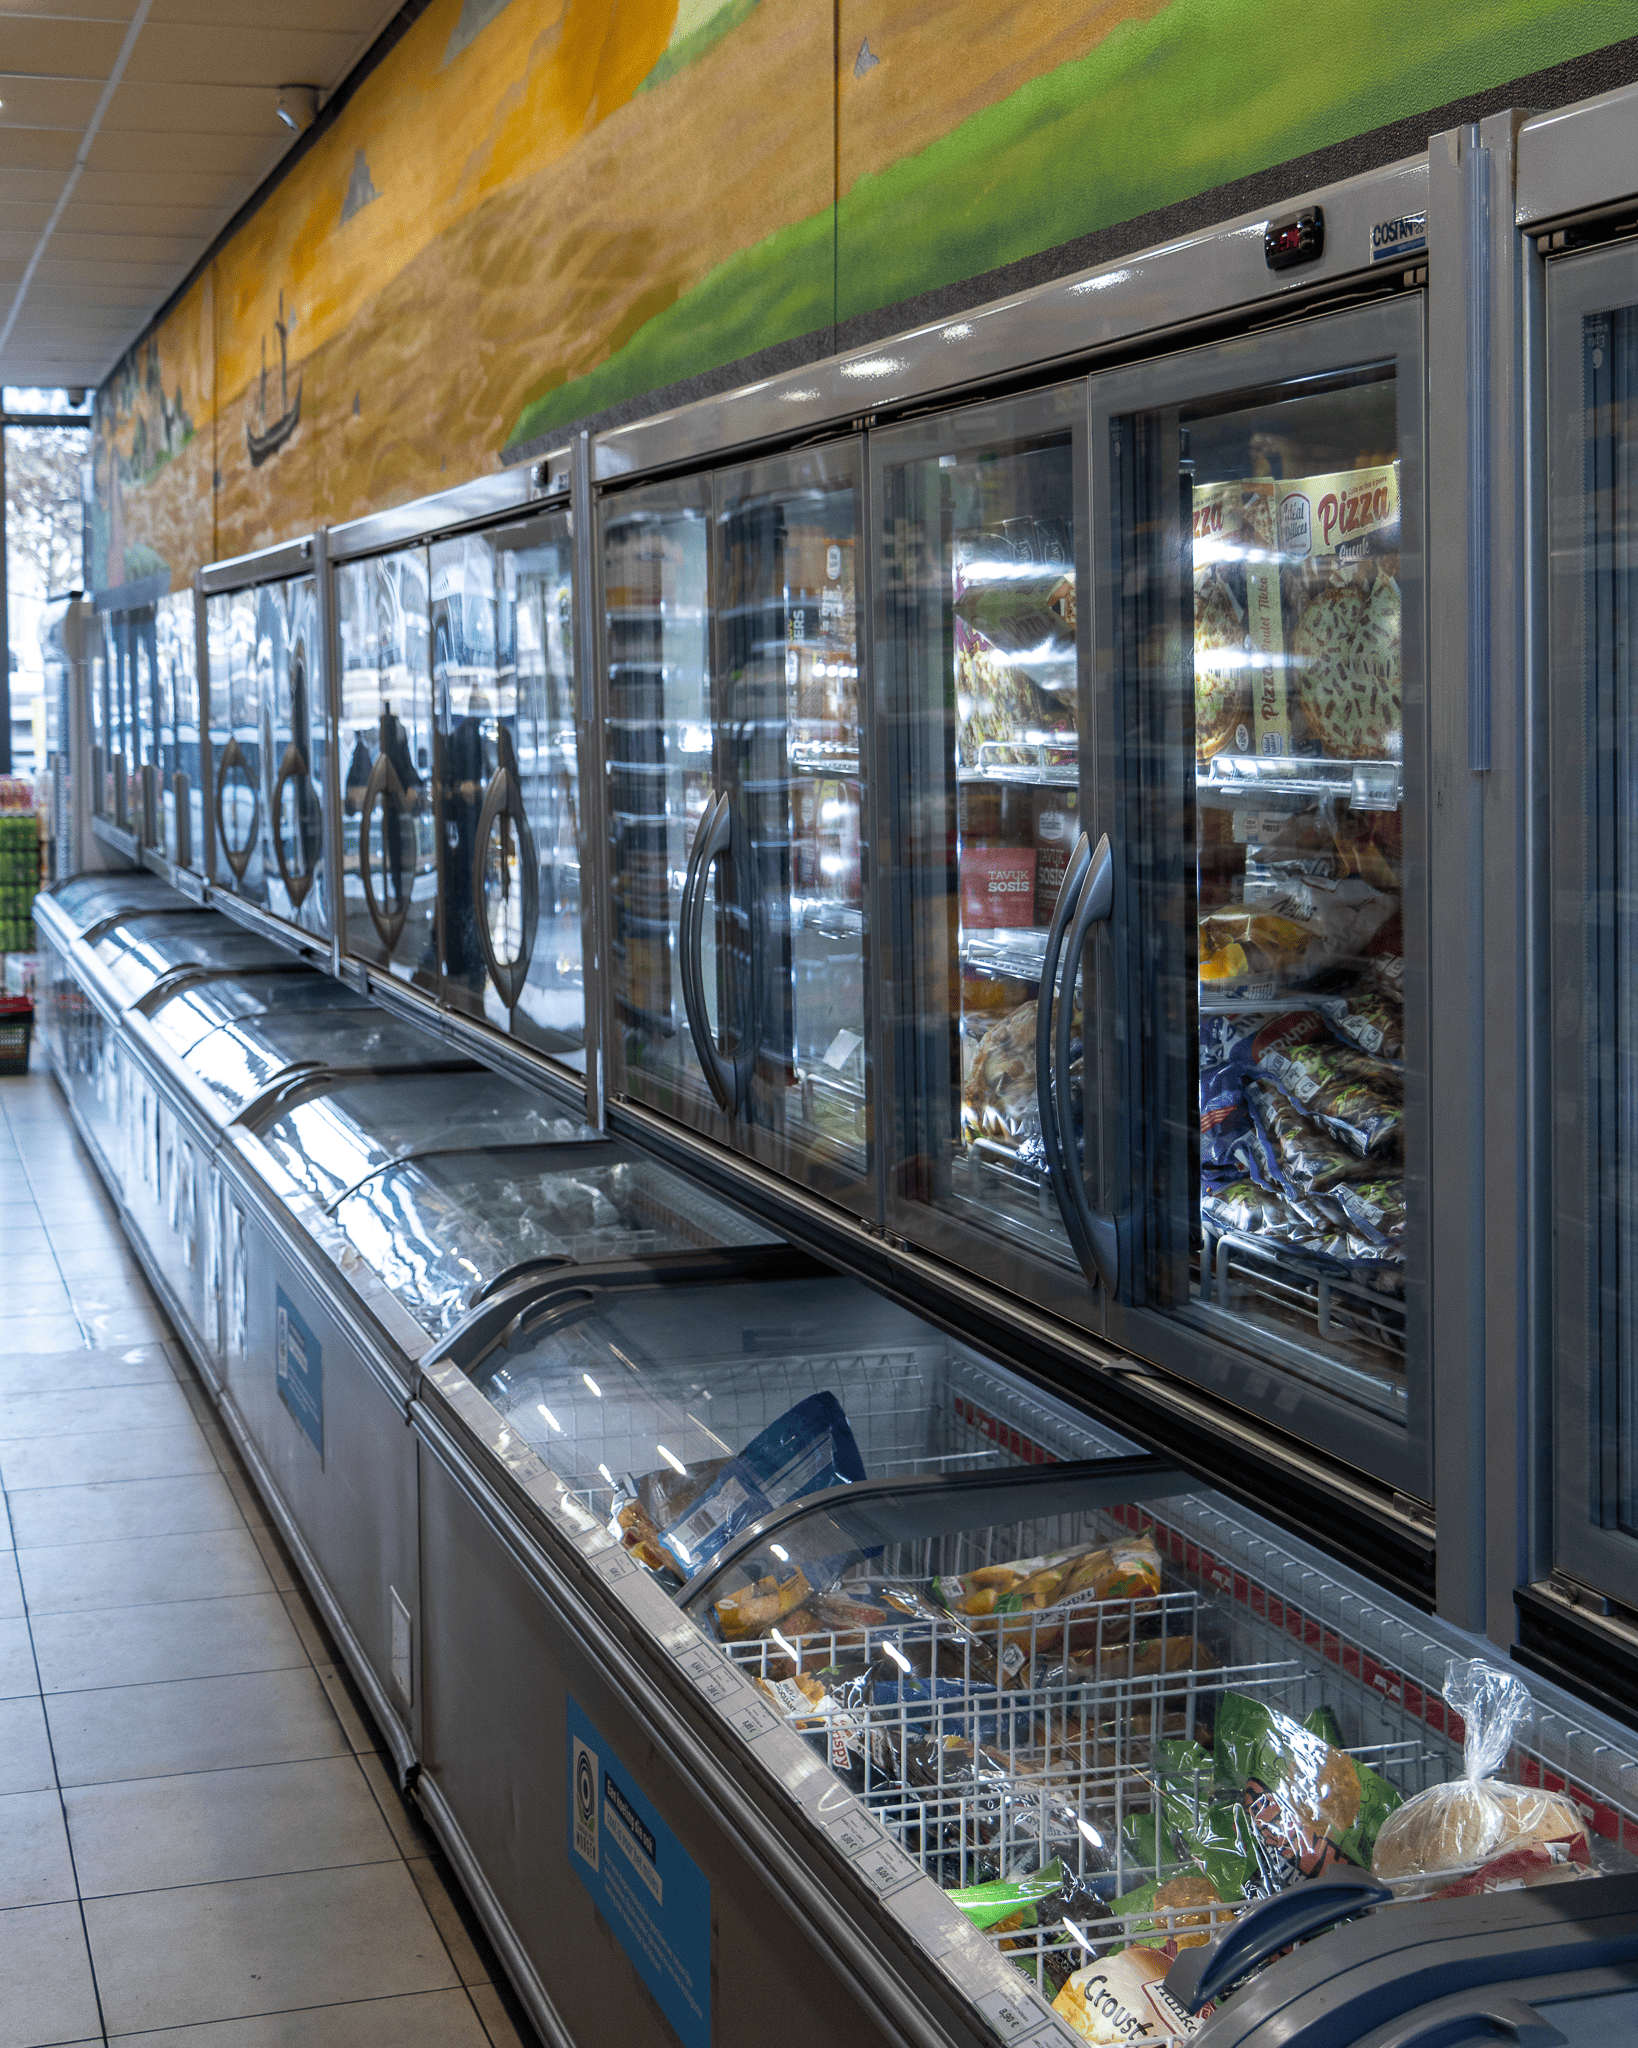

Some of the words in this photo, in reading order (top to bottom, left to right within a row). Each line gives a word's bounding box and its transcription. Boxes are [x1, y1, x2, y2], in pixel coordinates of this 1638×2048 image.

[1373, 218, 1413, 247] COSTAN
[1285, 502, 1305, 522] Idéal
[1318, 486, 1391, 546] Pizza
[1284, 521, 1308, 542] Délices
[1339, 536, 1370, 566] Sucuk
[1258, 576, 1271, 613] Tikka
[988, 870, 1030, 881] TAVUK
[998, 2008, 1015, 2023] 8,90
[1083, 1974, 1156, 2041] Croust
